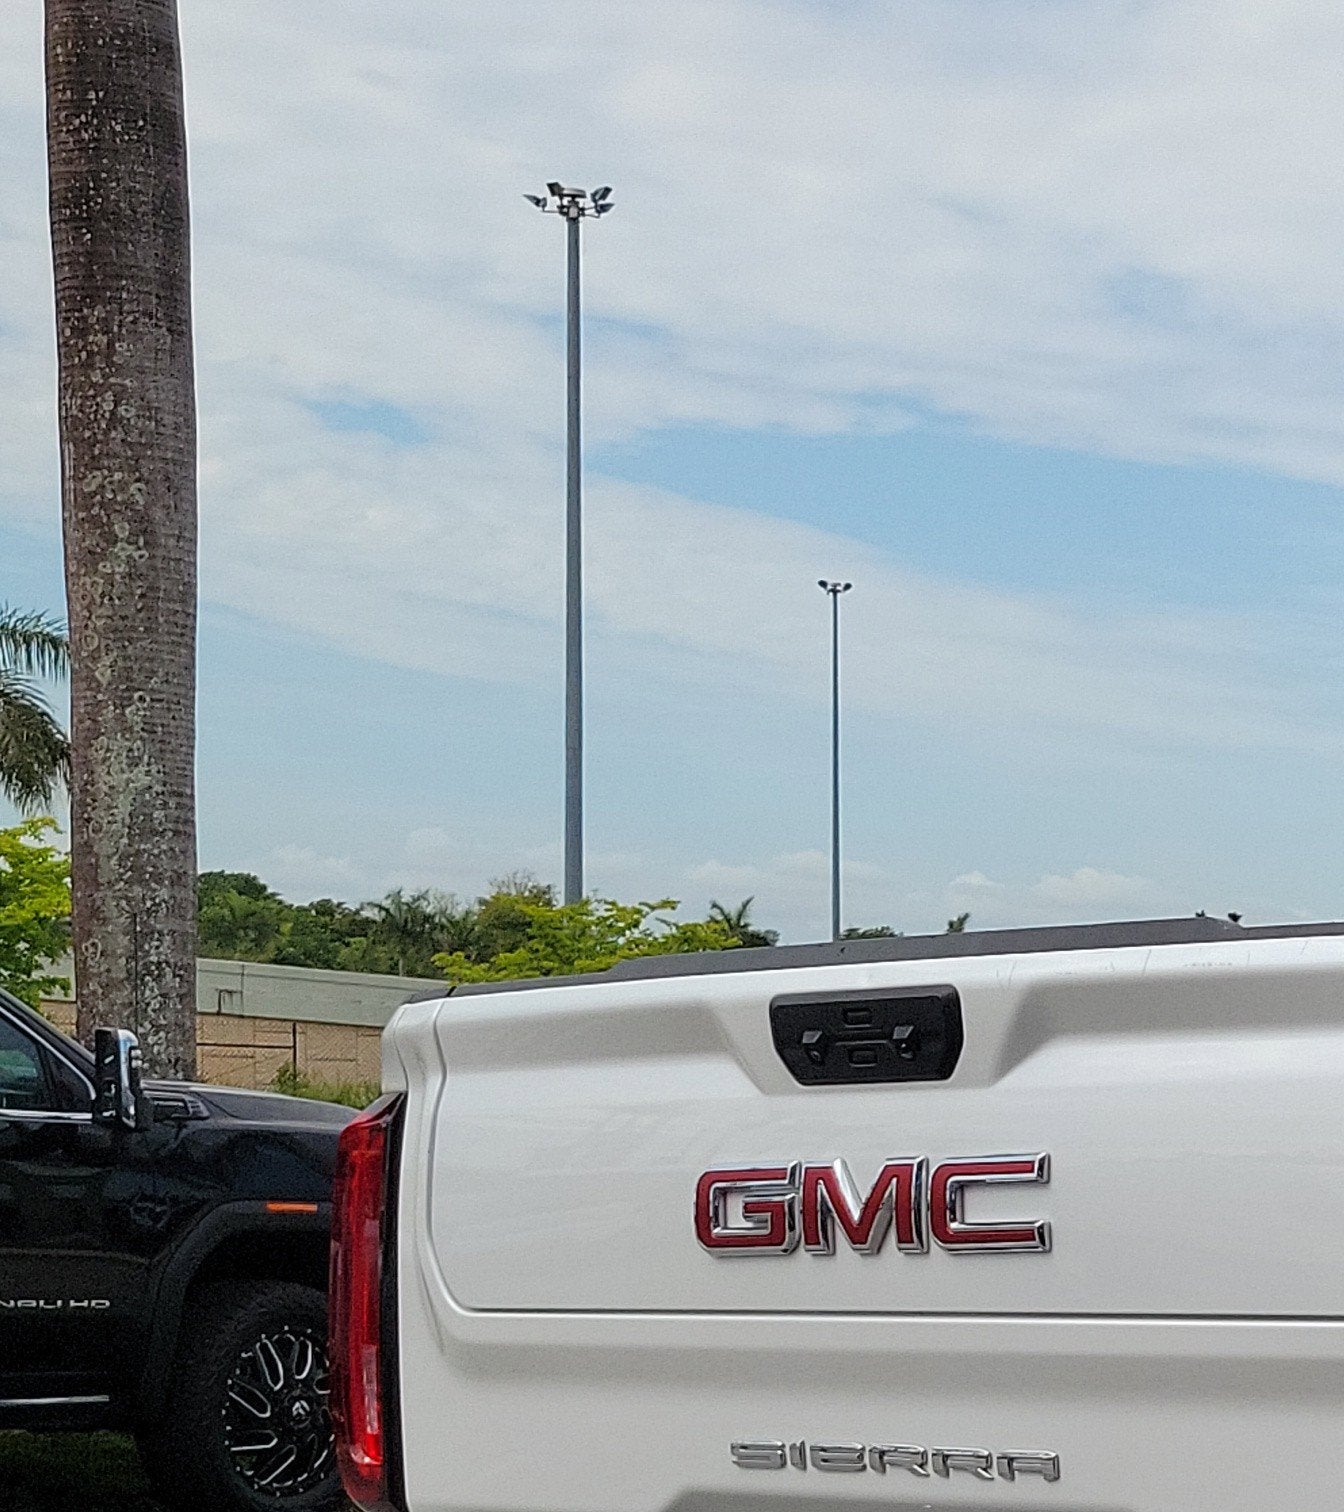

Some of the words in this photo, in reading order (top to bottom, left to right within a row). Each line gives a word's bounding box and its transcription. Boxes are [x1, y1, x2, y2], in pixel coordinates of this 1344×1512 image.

[694, 1151, 1052, 1257] GMC
[69, 1299, 110, 1309] HD
[730, 1438, 1061, 1481] SIERRA
